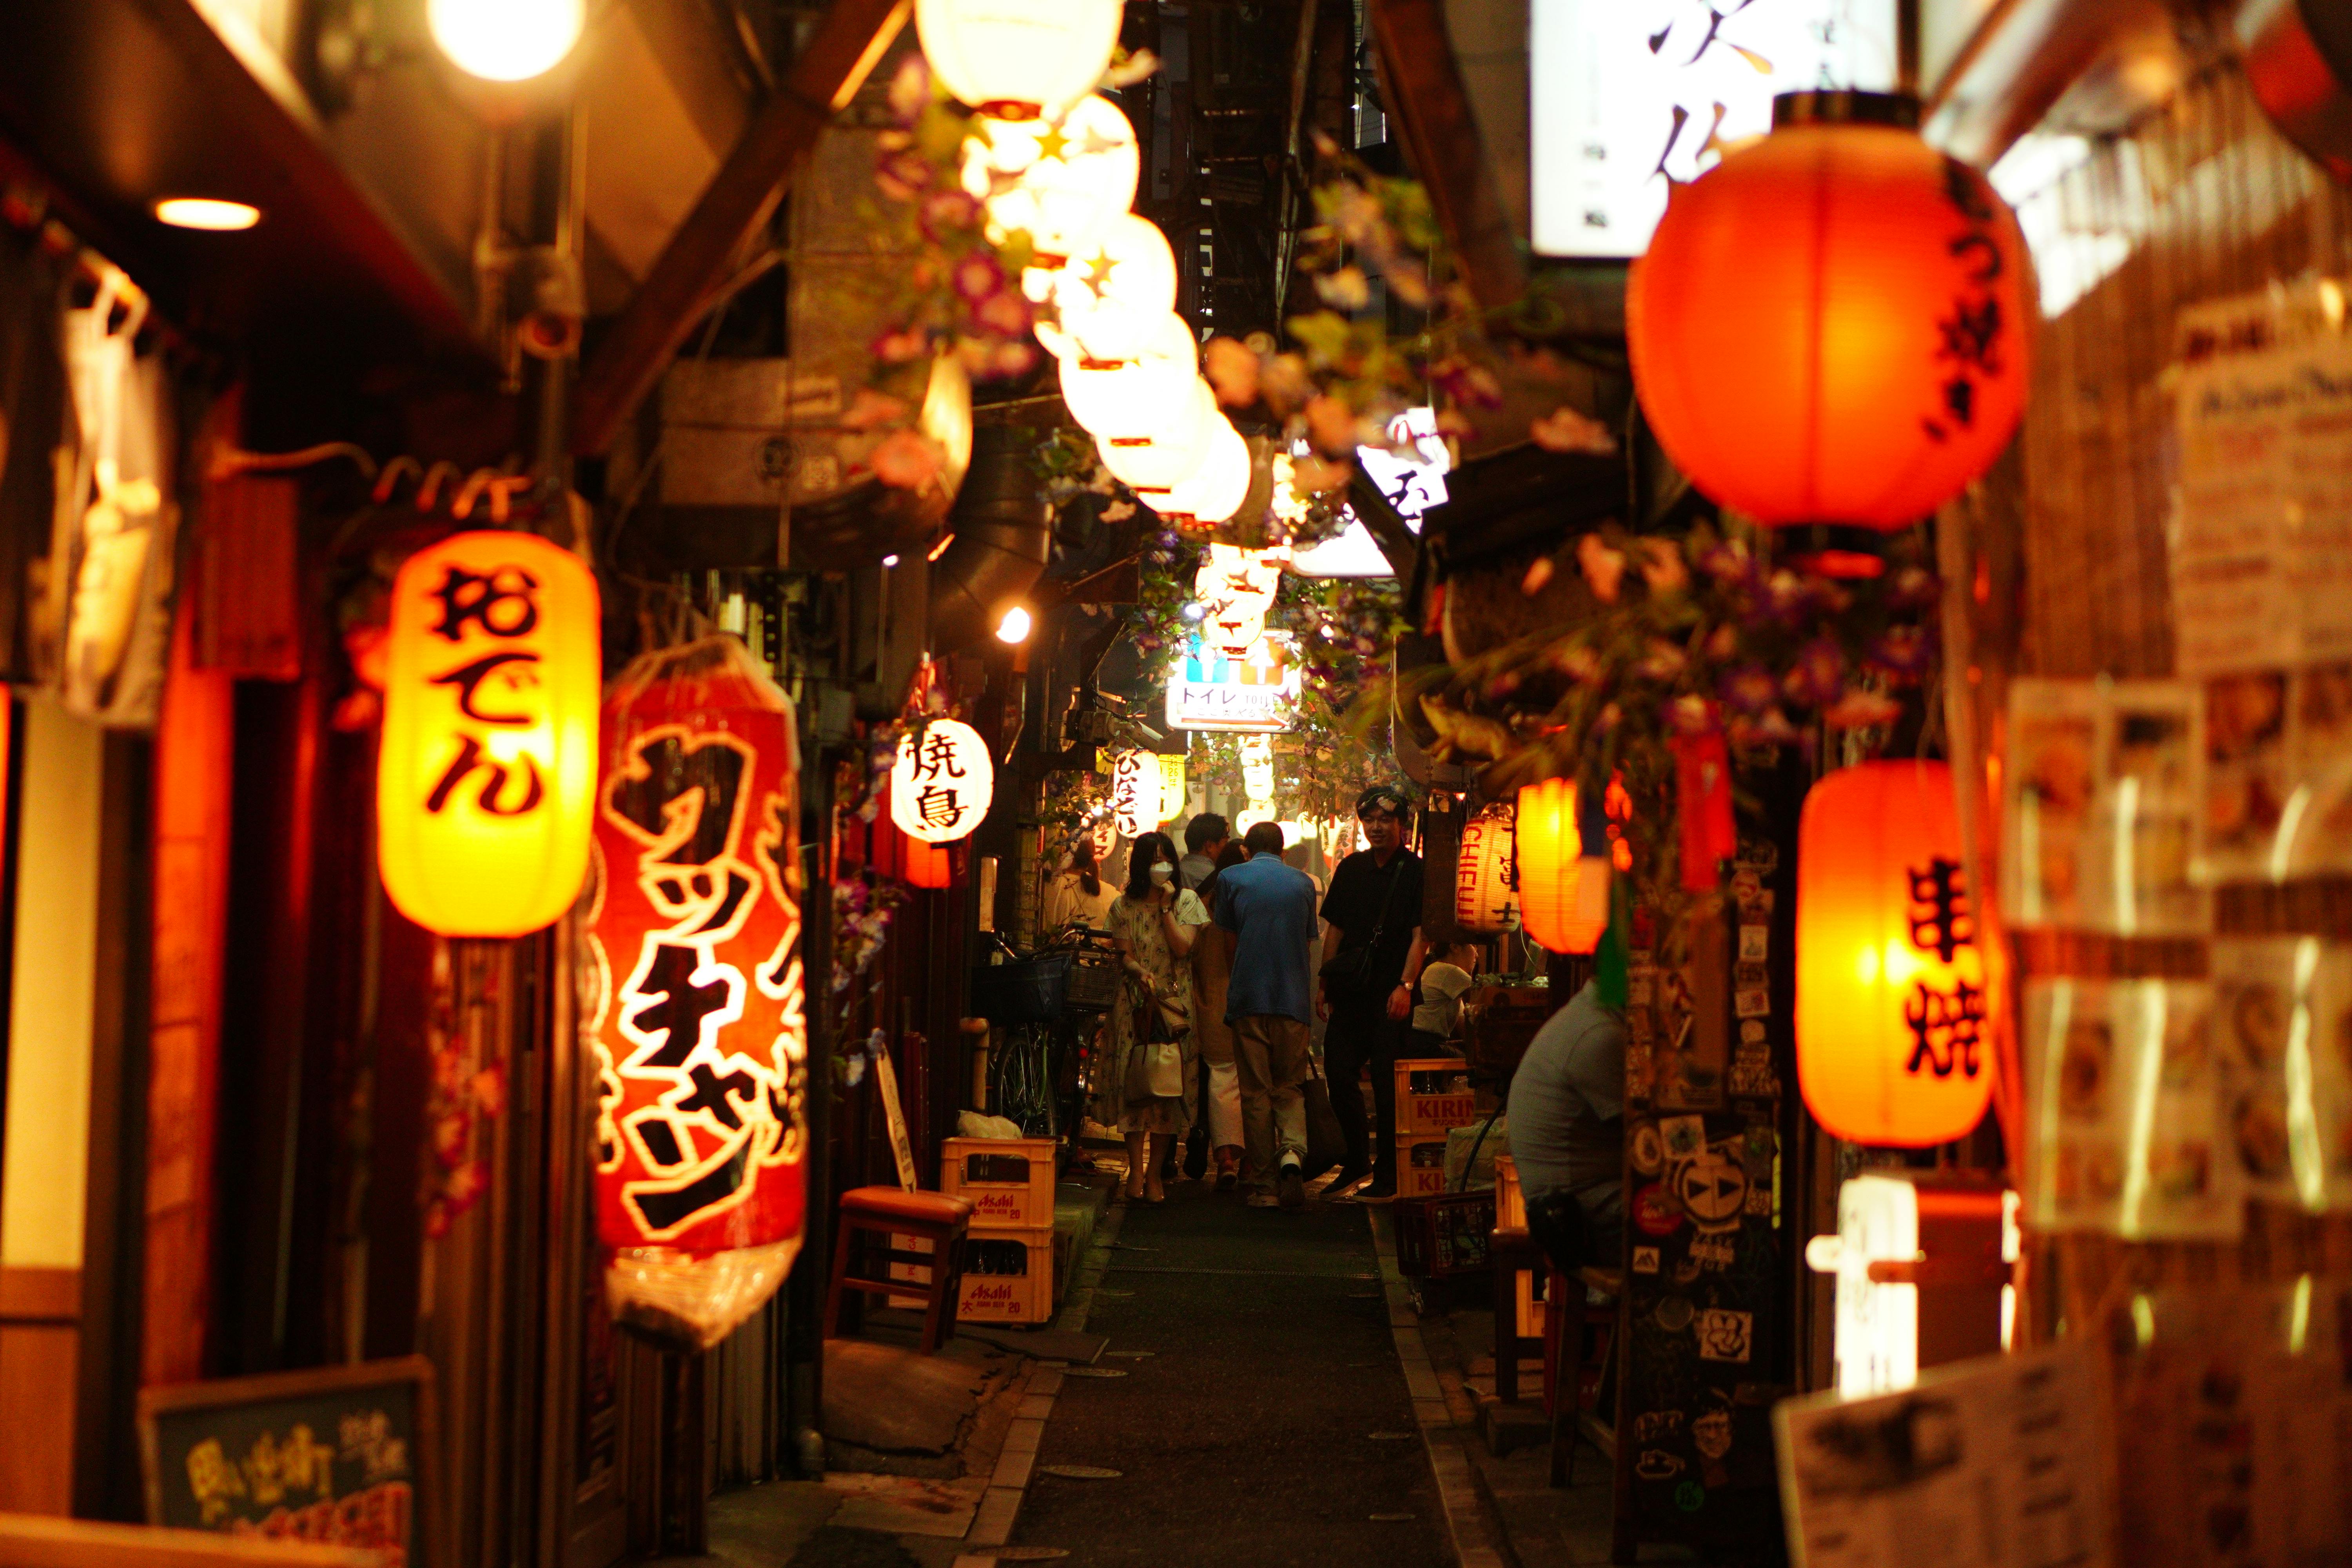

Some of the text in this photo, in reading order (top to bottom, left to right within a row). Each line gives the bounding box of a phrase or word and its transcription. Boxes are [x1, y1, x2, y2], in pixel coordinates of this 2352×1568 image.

[1183, 687, 1279, 705] トイレ TOILE
[905, 734, 968, 830] 焼鳥
[1115, 755, 1141, 834] ひなどり
[1457, 819, 1486, 926] ICHIFUJI
[978, 1193, 1014, 1207] Asahi
[1010, 1209, 1021, 1219] 20
[970, 1283, 1012, 1299] Asahi
[961, 1300, 973, 1312] 大
[1008, 1301, 1020, 1313] 20
